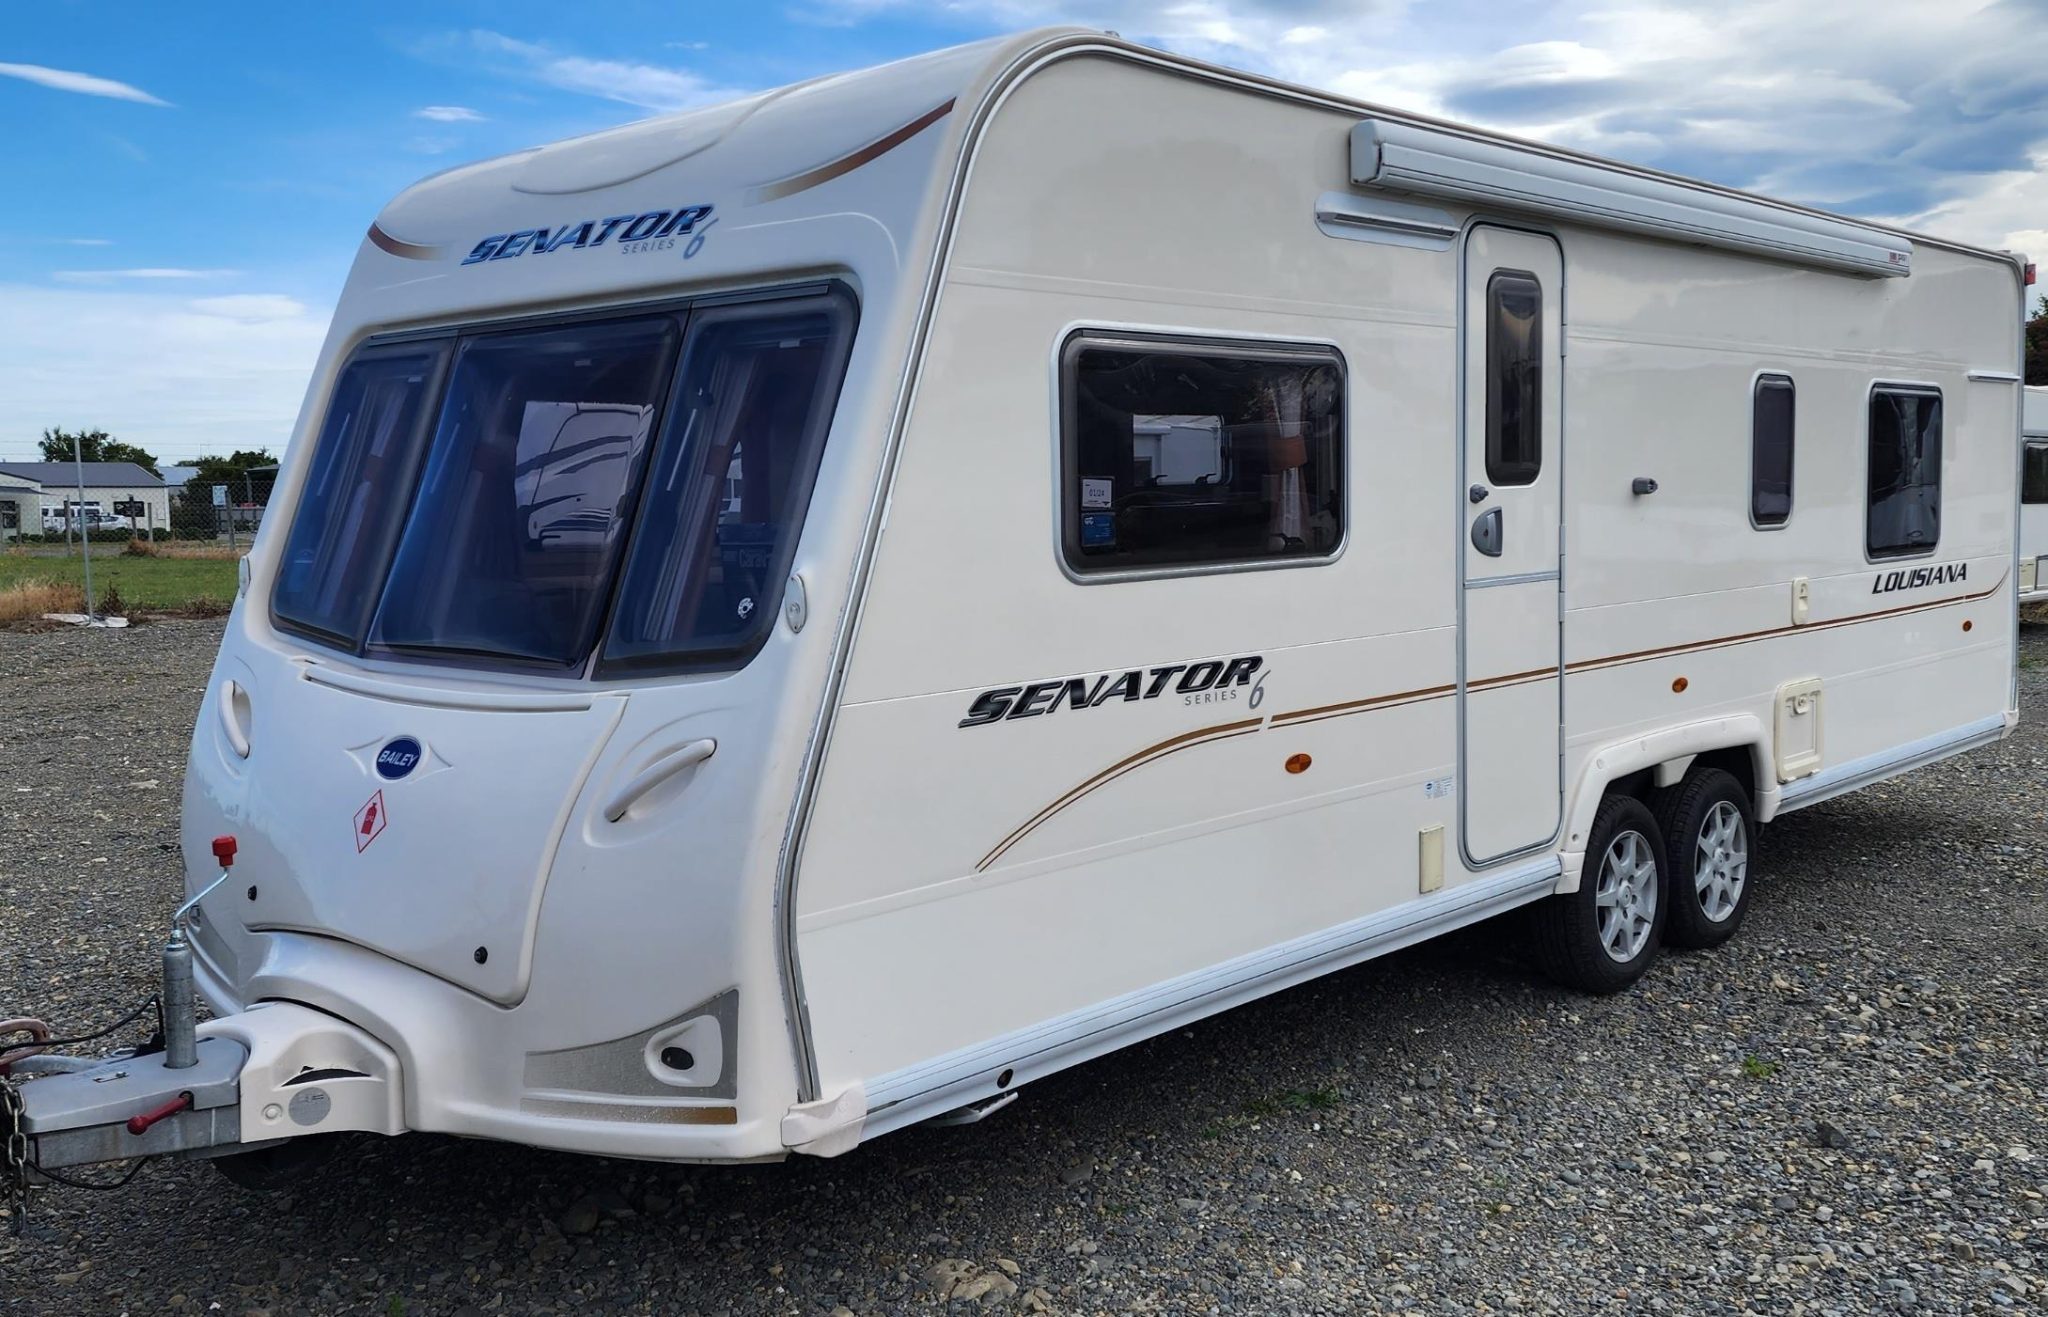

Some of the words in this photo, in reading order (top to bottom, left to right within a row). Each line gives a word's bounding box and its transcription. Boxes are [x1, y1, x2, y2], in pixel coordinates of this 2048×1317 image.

[460, 203, 714, 266] SENATOR
[621, 239, 676, 255] SERIES
[682, 217, 719, 260] 6
[1871, 562, 1967, 594] LOUISIANA
[958, 655, 1263, 728] SENATOR
[1184, 689, 1237, 706] SERIES
[1248, 668, 1271, 710] 6
[378, 750, 419, 766] BAILEY
